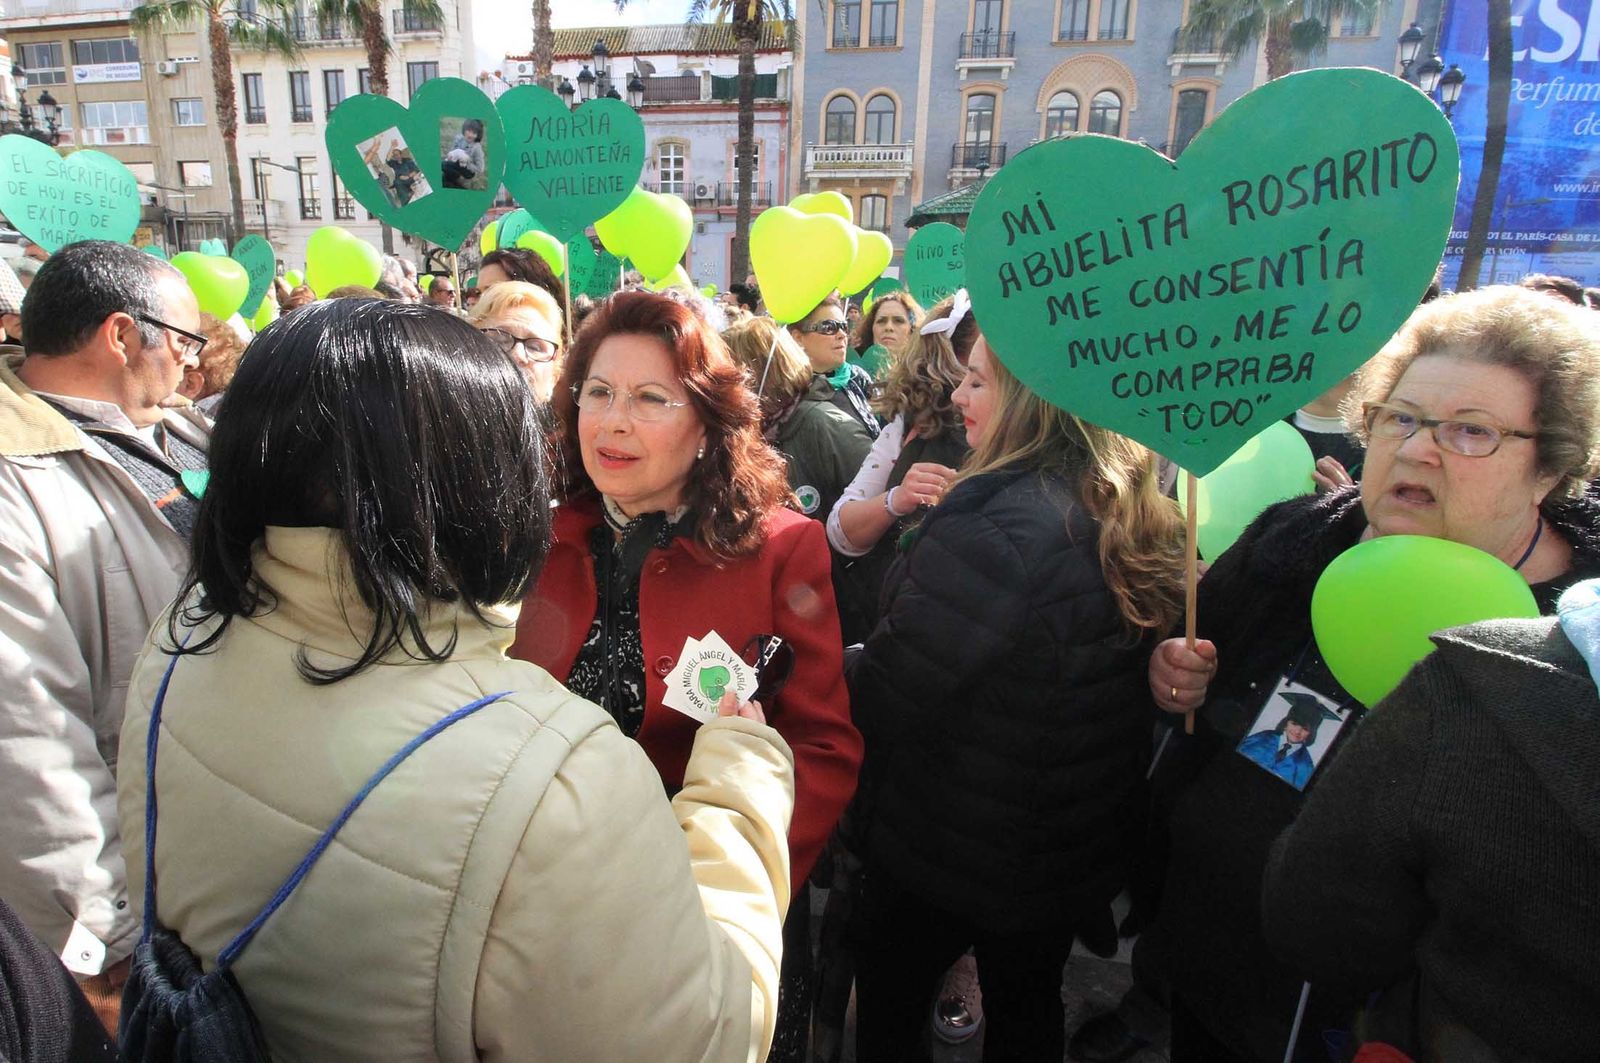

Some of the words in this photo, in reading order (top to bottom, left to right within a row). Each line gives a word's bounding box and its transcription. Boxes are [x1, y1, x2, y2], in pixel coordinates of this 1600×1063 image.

[11, 154, 32, 174] EL
[519, 140, 631, 172] ALMONTEÑA
[7, 180, 28, 196] DE
[39, 184, 65, 201] HOY
[74, 192, 94, 206] ES
[100, 196, 117, 209] EL
[91, 214, 110, 228] DE
[998, 203, 1189, 298] ABUELITA
[1222, 131, 1438, 226] ROSARITO
[1046, 286, 1102, 325] ME
[1129, 226, 1364, 308] CONSENTÍA
[1233, 304, 1296, 342] ME
[1311, 301, 1362, 336] LO
[1111, 352, 1315, 399] COMPRABA
[682, 658, 699, 688] MIGUEL
[727, 656, 734, 665] Y
[686, 688, 704, 709] PARA
